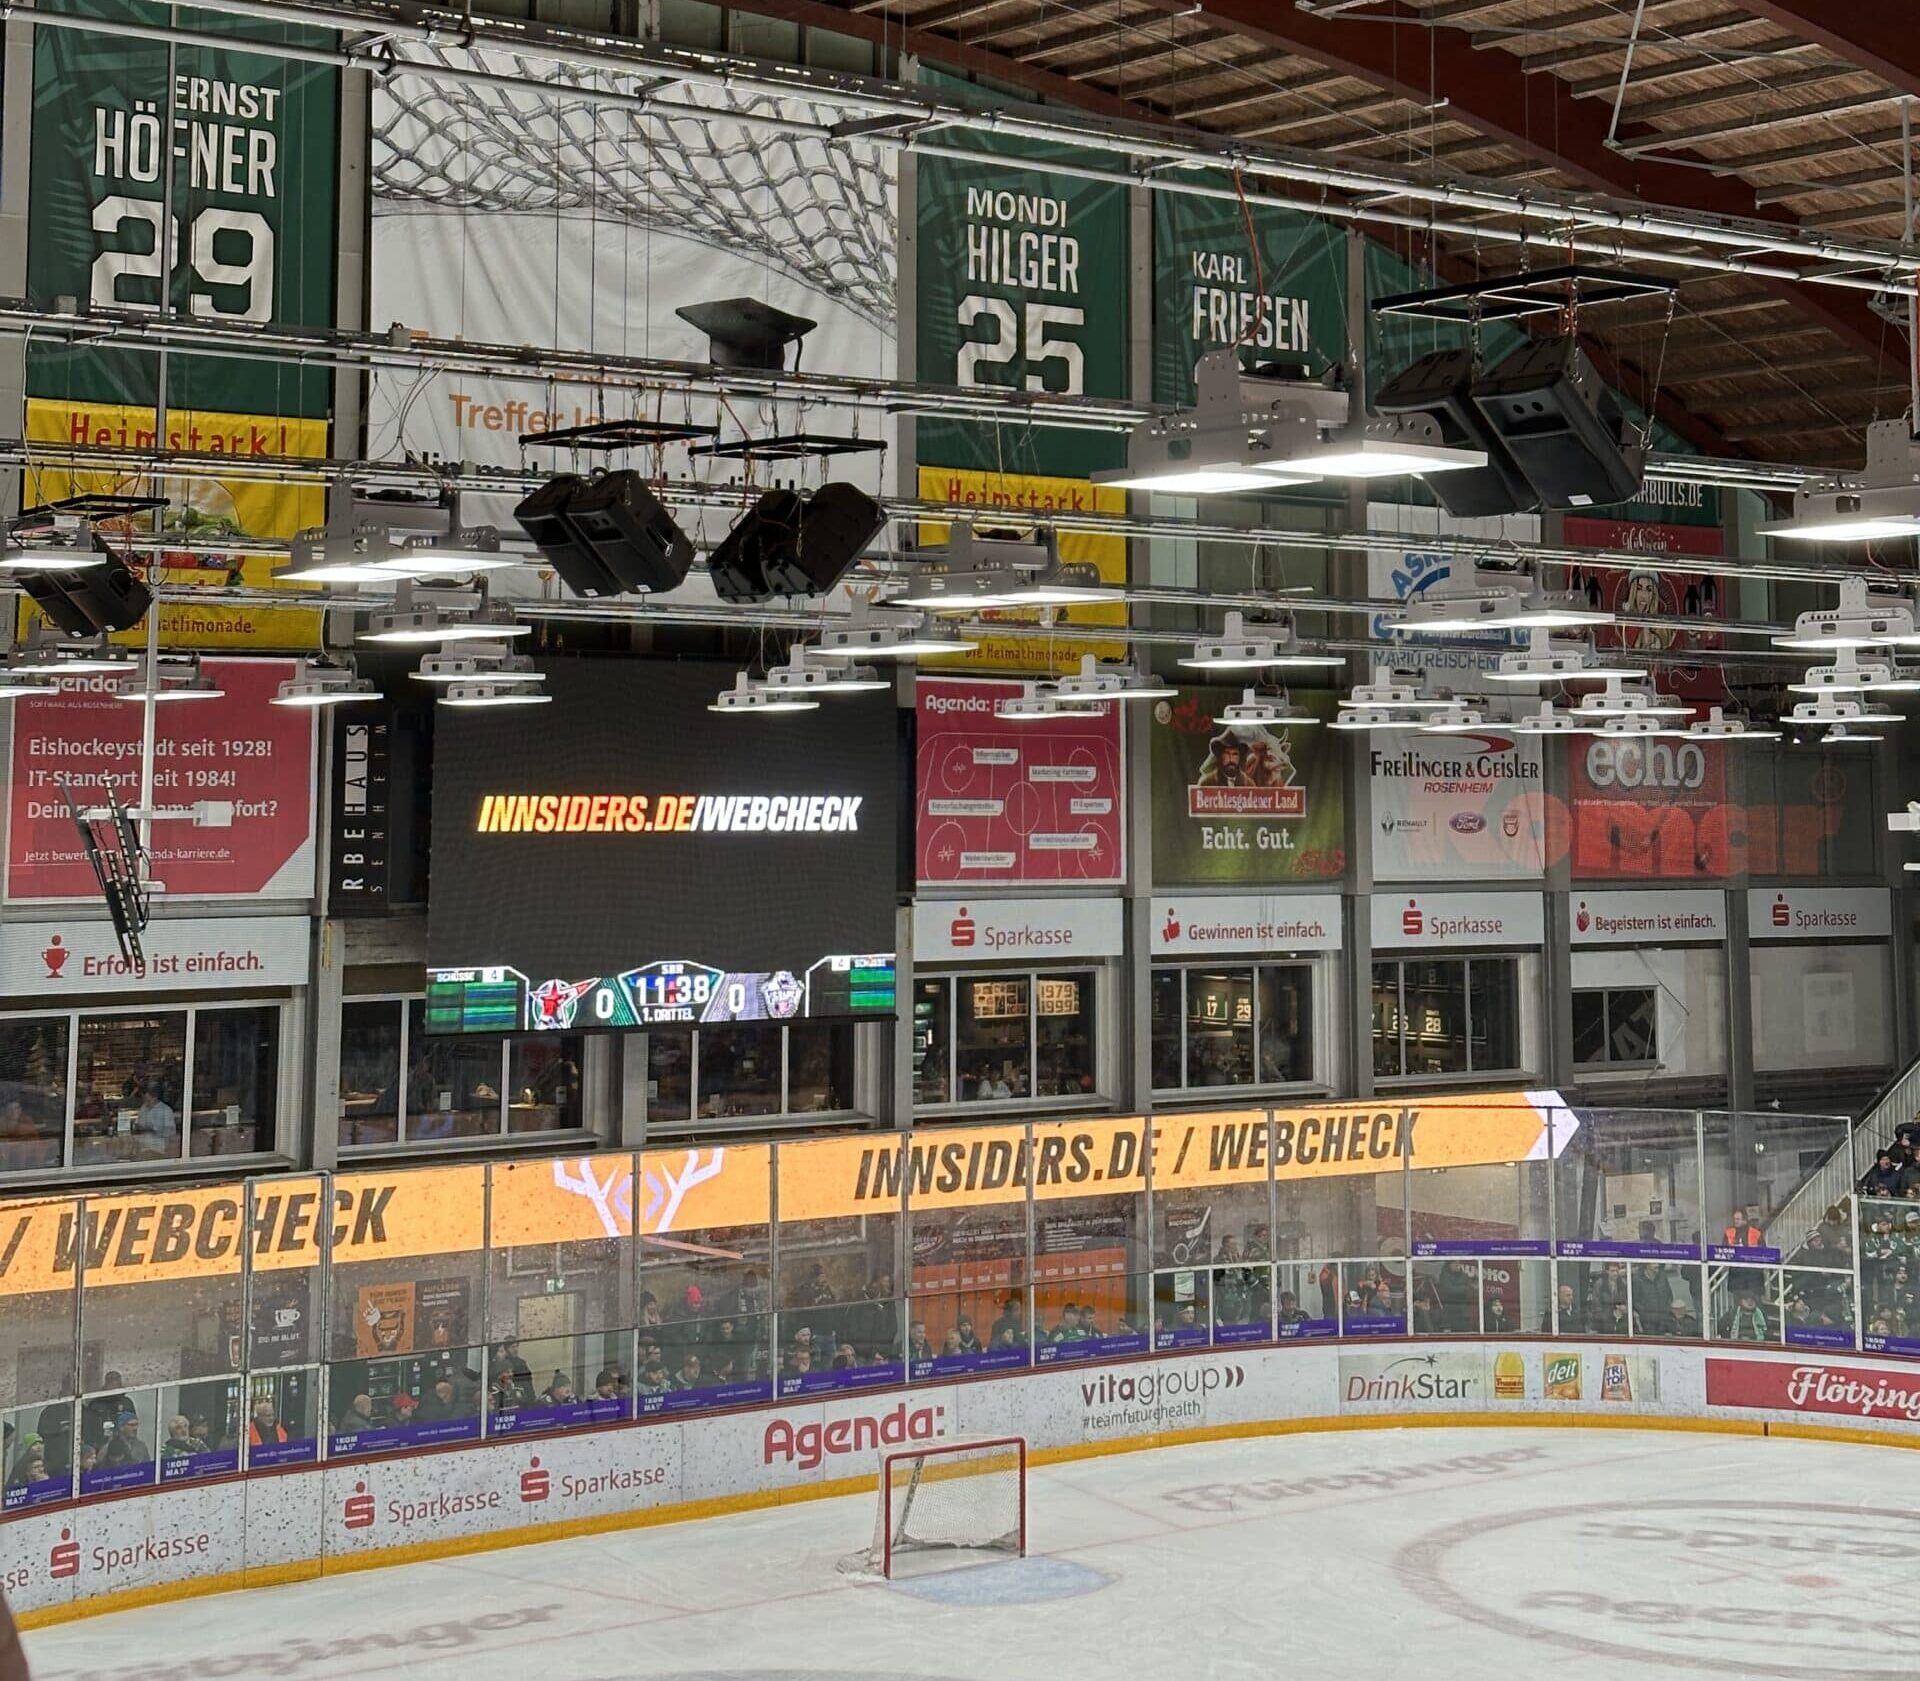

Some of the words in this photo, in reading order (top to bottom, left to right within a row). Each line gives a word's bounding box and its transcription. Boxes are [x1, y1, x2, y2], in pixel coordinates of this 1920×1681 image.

[174, 75, 281, 122] ERNST
[94, 100, 277, 198] HÖFNER
[967, 187, 1067, 228] MONDI
[89, 195, 275, 324] 29
[967, 223, 1080, 293] HILGER
[1192, 250, 1247, 285] KARL
[1192, 285, 1309, 352] FRIESEN
[956, 295, 1085, 395] 25
[449, 393, 564, 434] Treffer
[70, 411, 287, 457] Heimstark!
[949, 477, 1097, 511] Heimstark!
[1630, 479, 1703, 507] RBULLS.DE
[50, 674, 121, 695] genda
[925, 694, 990, 714] Agenda:
[29, 736, 176, 760] Eishockeystdt
[181, 739, 216, 756] seit
[221, 739, 272, 757] 1928!
[1586, 736, 1705, 788] echo
[185, 771, 236, 787] 1984!
[1423, 782, 1494, 793] ROSENHEIM
[27, 801, 71, 819] Dein
[1275, 791, 1298, 809] Land
[1202, 827, 1250, 849] Echt.
[1256, 827, 1295, 849] Gut.
[1189, 924, 1253, 941] Gewinnen
[1257, 924, 1274, 939] ist
[1277, 920, 1327, 938] einfach.
[1430, 915, 1503, 938] Sparkasse
[1596, 915, 1655, 935] Begeistern
[1658, 916, 1671, 929] ist
[1674, 914, 1716, 929] einfach.
[1796, 909, 1857, 930] Sparkasse
[984, 926, 1073, 954] Sparkasse
[153, 953, 178, 973] ist
[185, 950, 265, 972] einfach.
[596, 988, 614, 1019] 0
[728, 983, 746, 1013] 0
[854, 1127, 1160, 1200] INNSIDERS.DE
[1209, 1111, 1420, 1171] WEBCHECK
[52, 1186, 397, 1273] WEBCHECK
[1548, 1358, 1577, 1382] deit
[1081, 1367, 1220, 1408] vitagroup
[764, 1403, 945, 1470] Agenda:
[561, 1464, 665, 1500] Sparkasse
[388, 1489, 500, 1526] Sparkasse
[92, 1533, 209, 1573] Sparkasse
